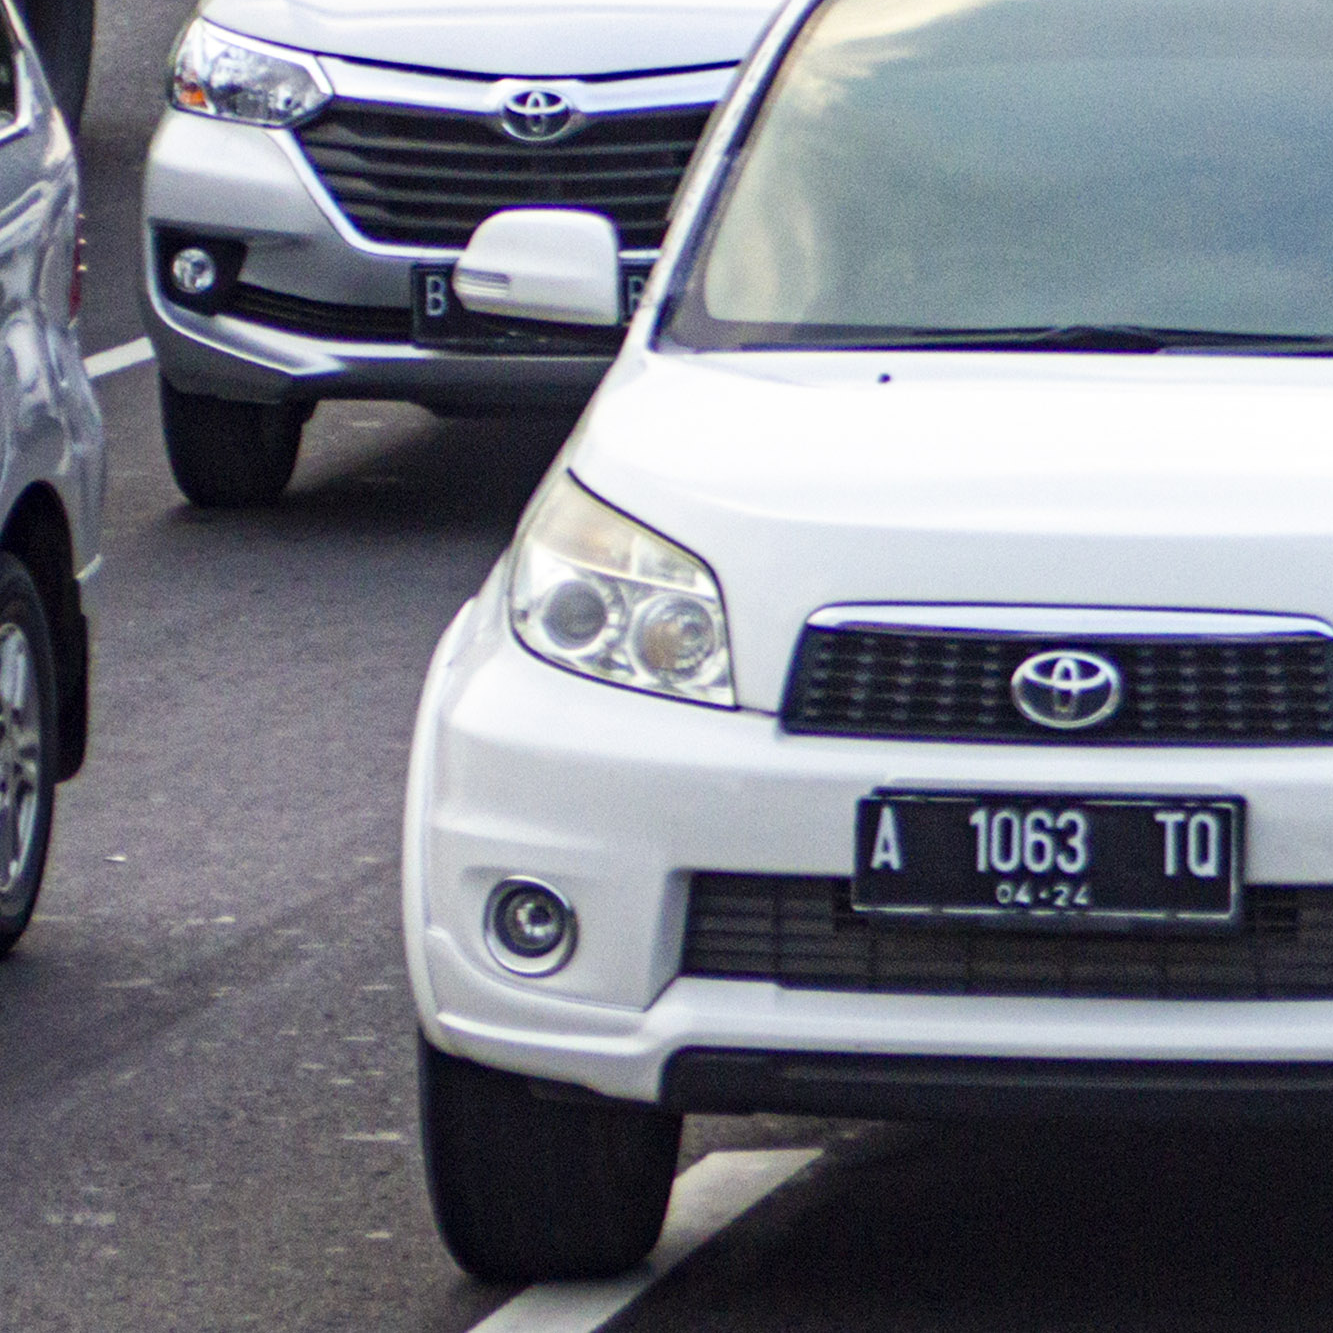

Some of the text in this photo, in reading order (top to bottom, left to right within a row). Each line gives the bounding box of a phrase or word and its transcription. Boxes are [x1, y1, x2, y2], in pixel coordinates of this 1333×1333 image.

[425, 274, 447, 317] B
[870, 806, 1220, 878] A 1063 TQ
